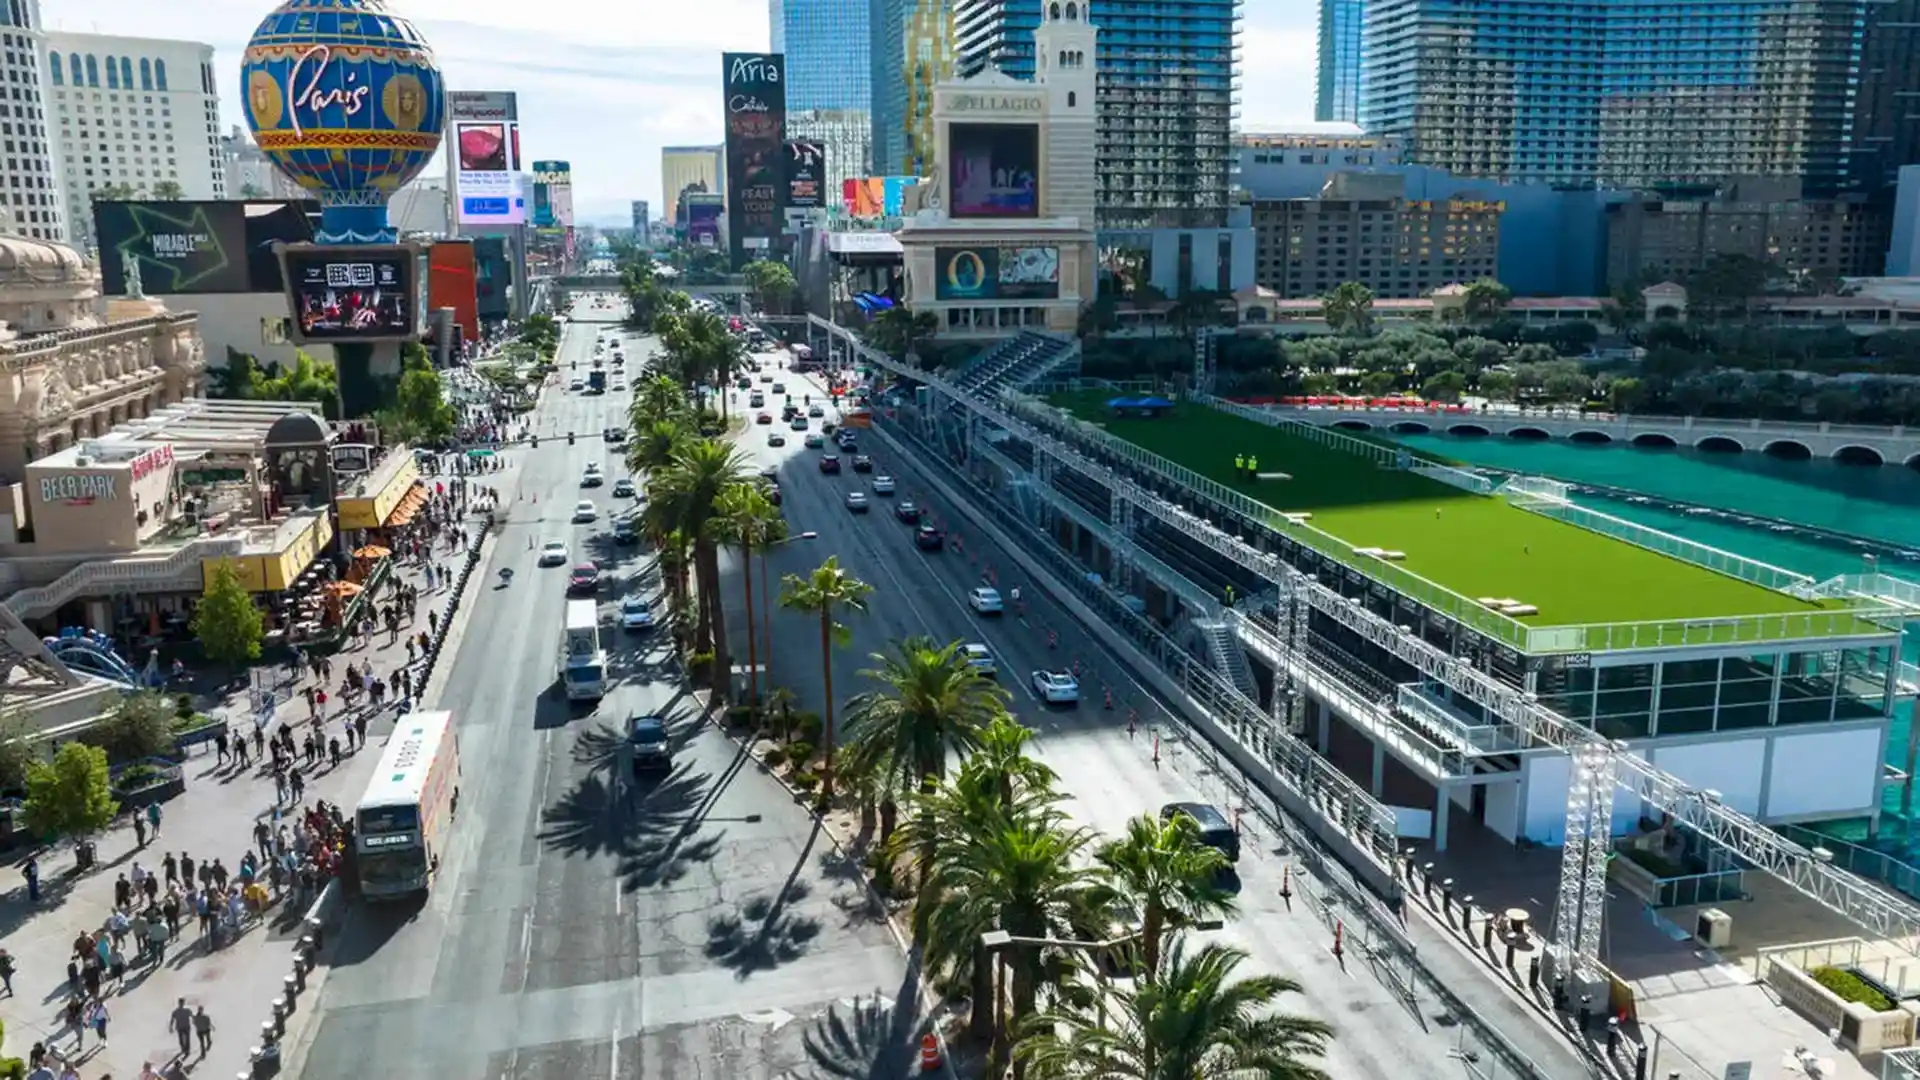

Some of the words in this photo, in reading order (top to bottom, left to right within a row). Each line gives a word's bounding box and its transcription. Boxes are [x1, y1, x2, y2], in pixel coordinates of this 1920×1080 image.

[731, 57, 778, 84] Aria
[288, 44, 368, 141] Paris
[946, 95, 1042, 111] BELLAGIO
[532, 171, 570, 184] MGM
[152, 234, 196, 253] MIRACLE
[41, 475, 77, 502] BEER
[80, 475, 117, 500] PARK
